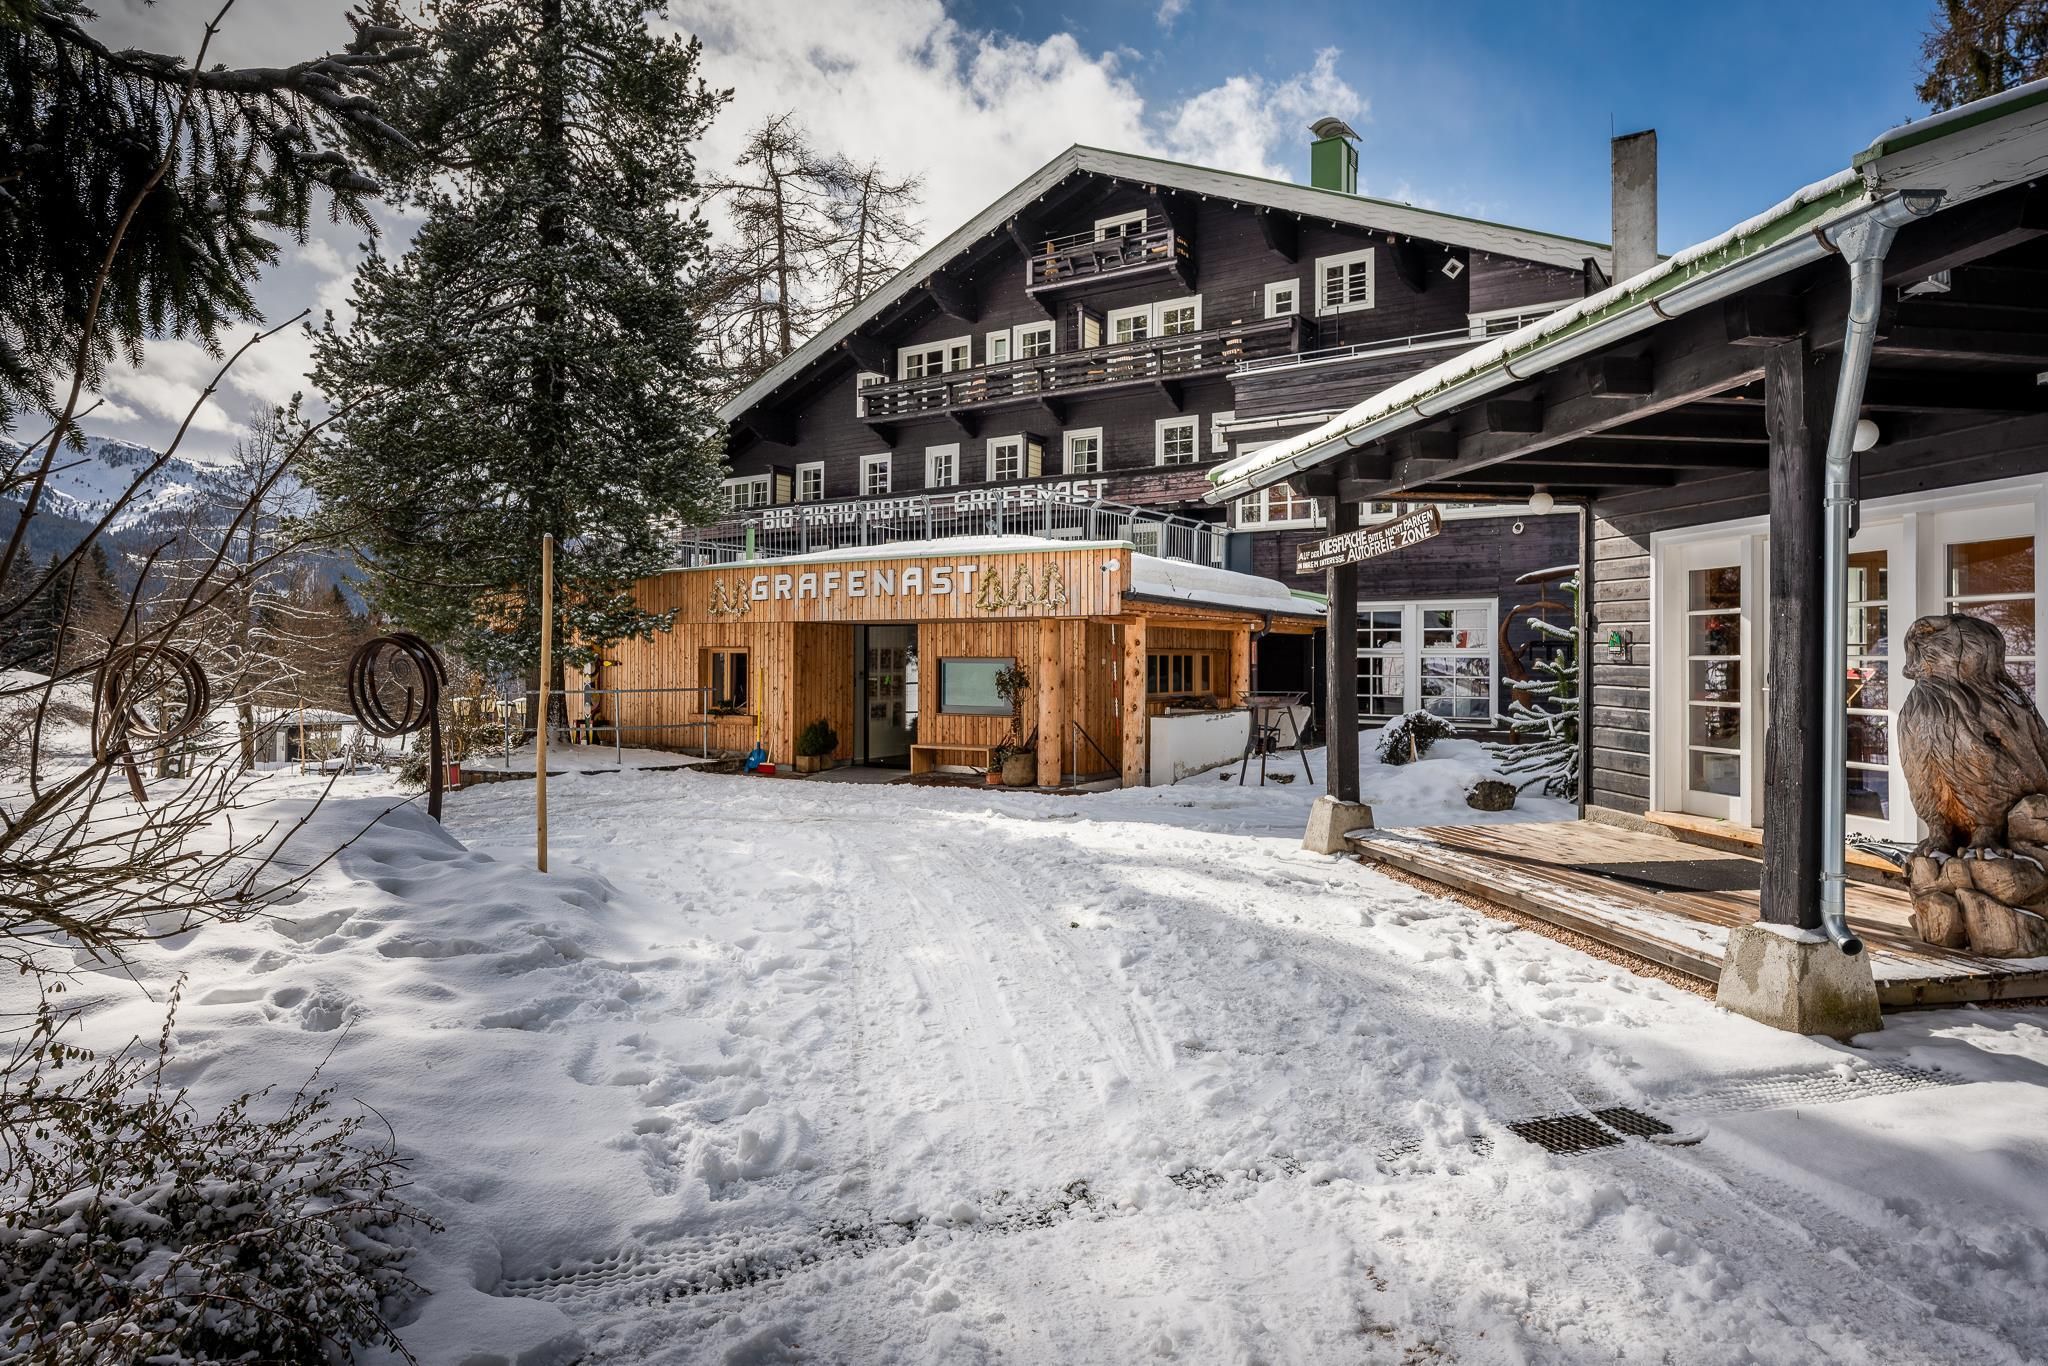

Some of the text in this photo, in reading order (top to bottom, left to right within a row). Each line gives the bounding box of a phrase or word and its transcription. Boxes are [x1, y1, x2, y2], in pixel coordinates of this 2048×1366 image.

[1298, 509, 1434, 561] AUF DER KIESFLÄCHE BITTE NICHT PARKEN
[1320, 554, 1345, 567] INTERESSE
[1347, 536, 1396, 562] AUTOFREIE
[1400, 523, 1431, 545] ZONE
[751, 564, 978, 602] GRAFENAST
